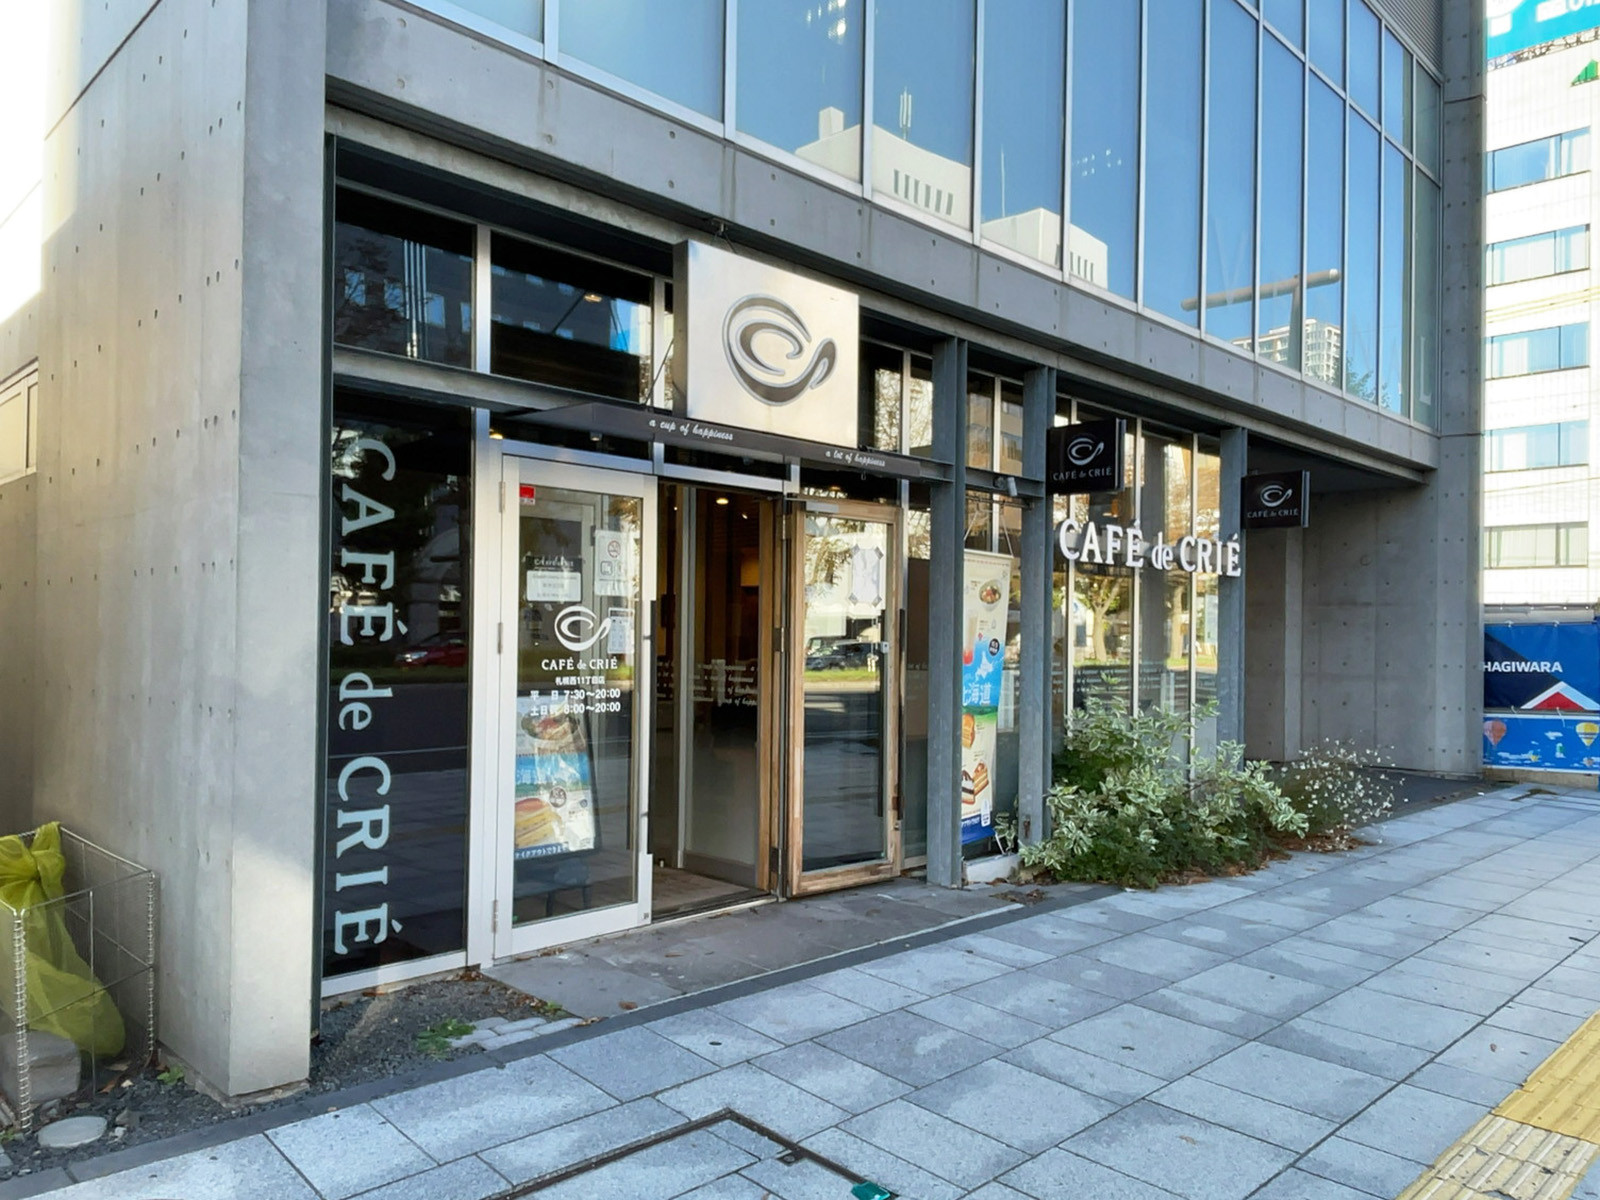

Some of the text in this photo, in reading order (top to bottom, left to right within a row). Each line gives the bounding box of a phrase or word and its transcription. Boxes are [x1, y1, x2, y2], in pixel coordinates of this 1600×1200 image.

[648, 419, 734, 441] a cup of happiness
[1058, 518, 1242, 577] CAFÉ de CRIÉ
[541, 656, 618, 671] CAFÉ de CRIÉ
[1483, 660, 1564, 673] HAGIWARA
[334, 438, 408, 955] CAFÉ de CRIÉ
